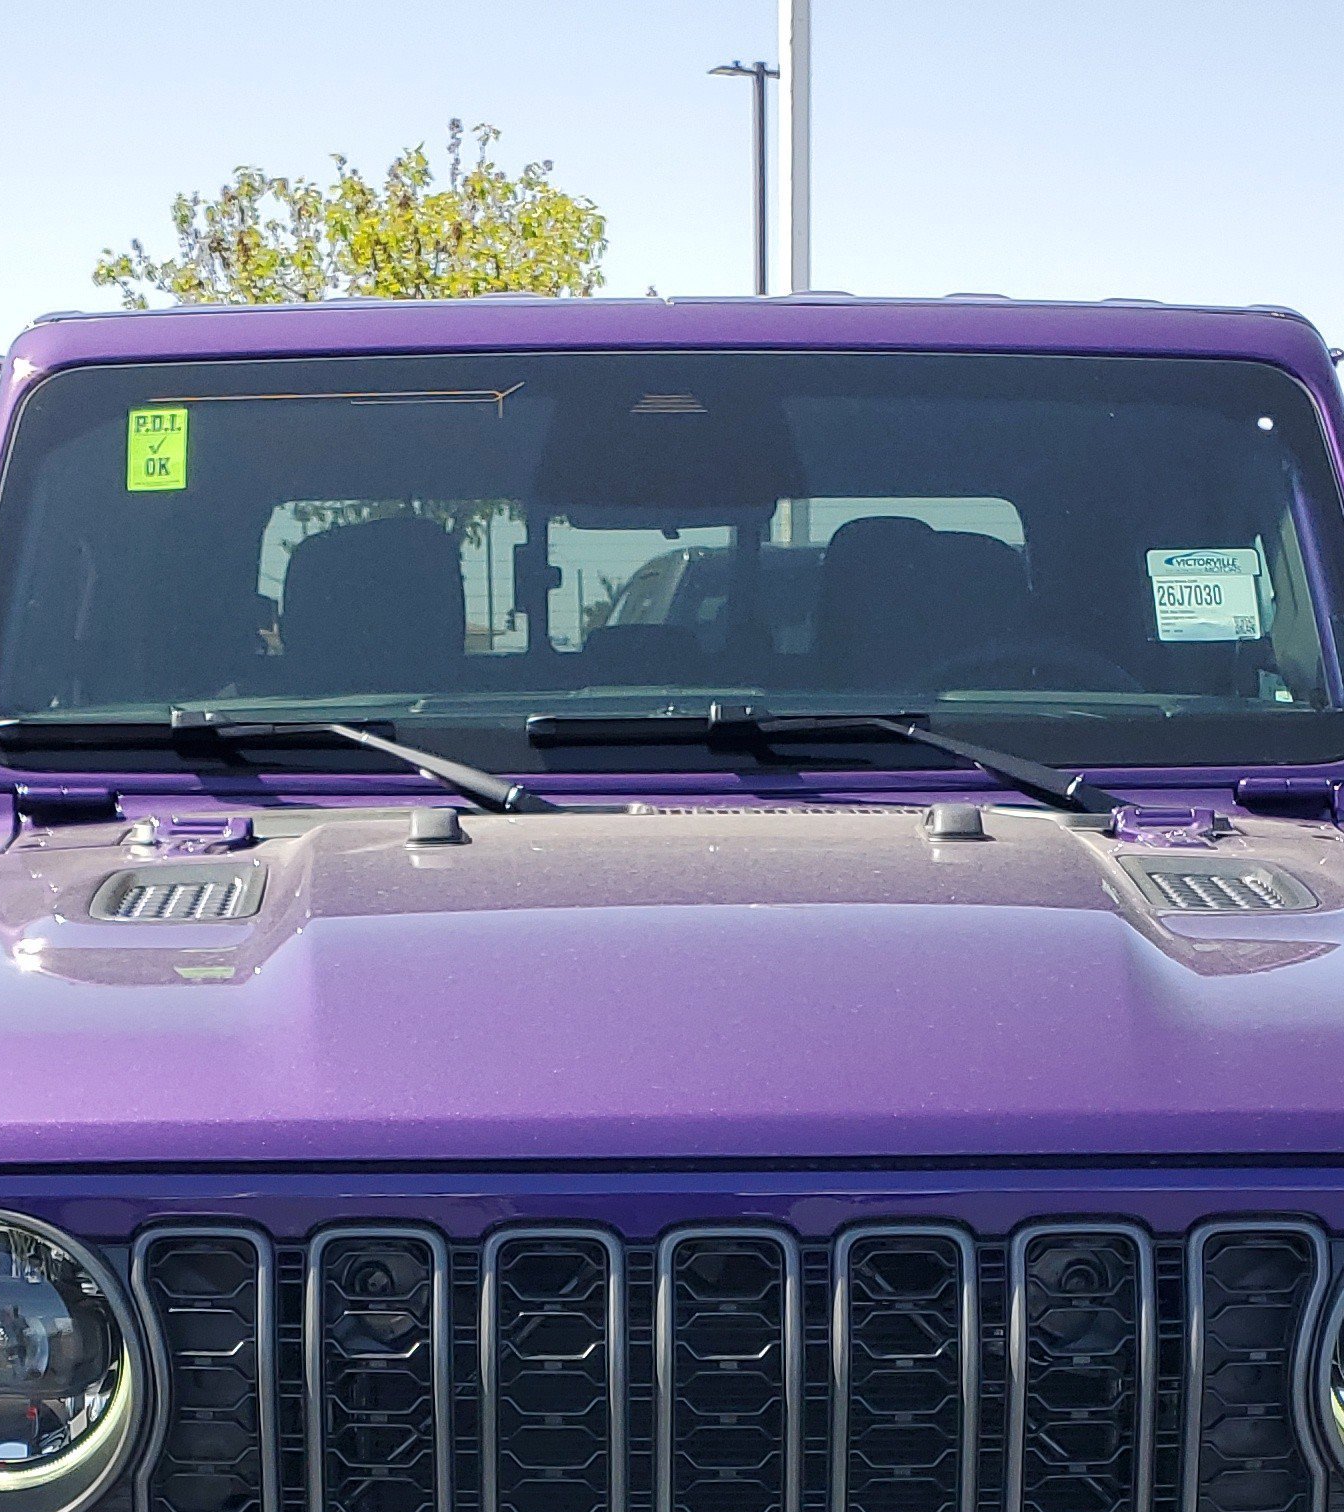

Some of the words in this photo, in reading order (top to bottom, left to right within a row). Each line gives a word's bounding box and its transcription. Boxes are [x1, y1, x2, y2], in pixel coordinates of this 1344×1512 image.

[135, 413, 182, 433] P.D.I.
[146, 458, 170, 477] OK
[1176, 558, 1238, 567] VICTORVILLE
[1158, 584, 1222, 607] 26J7030
